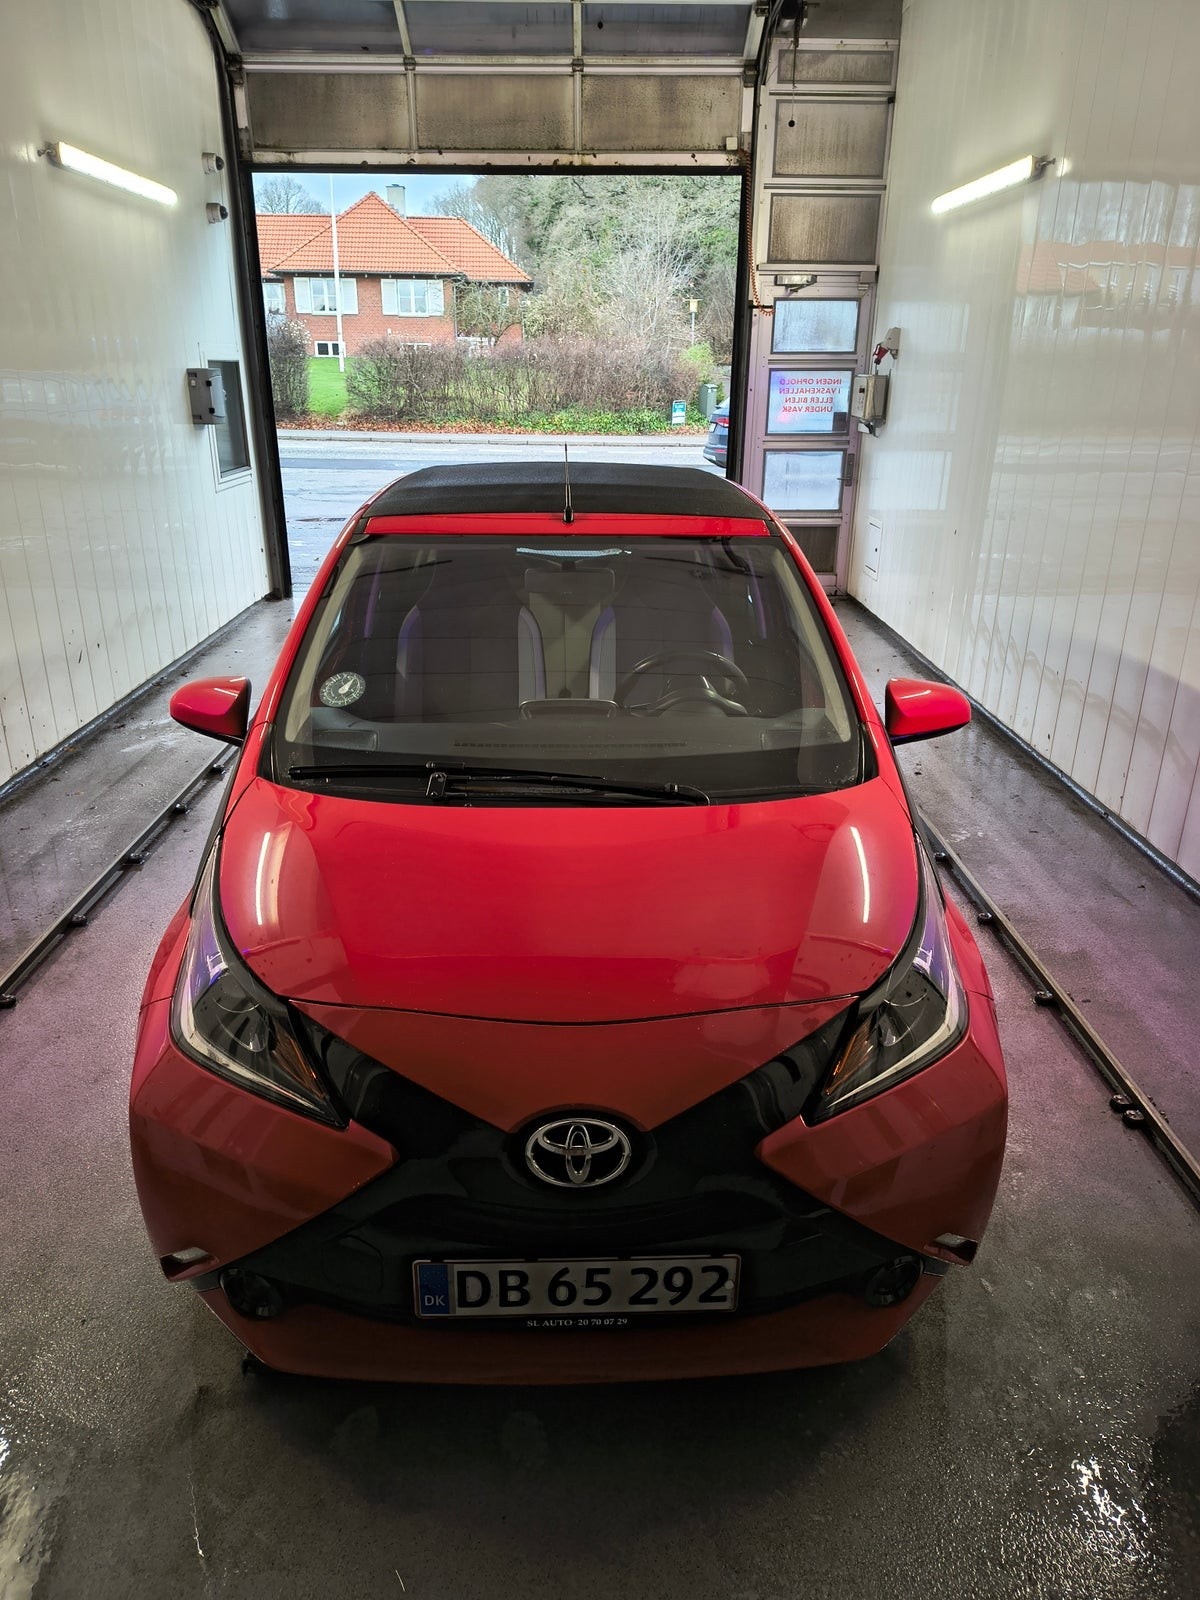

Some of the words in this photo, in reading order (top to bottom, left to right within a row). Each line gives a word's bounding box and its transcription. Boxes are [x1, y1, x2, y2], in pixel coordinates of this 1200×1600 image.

[456, 1269, 531, 1308] DB
[547, 1266, 612, 1307] 65
[628, 1265, 729, 1306] 292
[424, 1294, 445, 1307] DK
[527, 1319, 540, 1327] SL
[542, 1319, 573, 1327] AUTO
[591, 1318, 602, 1326] 70
[604, 1318, 615, 1326] 07
